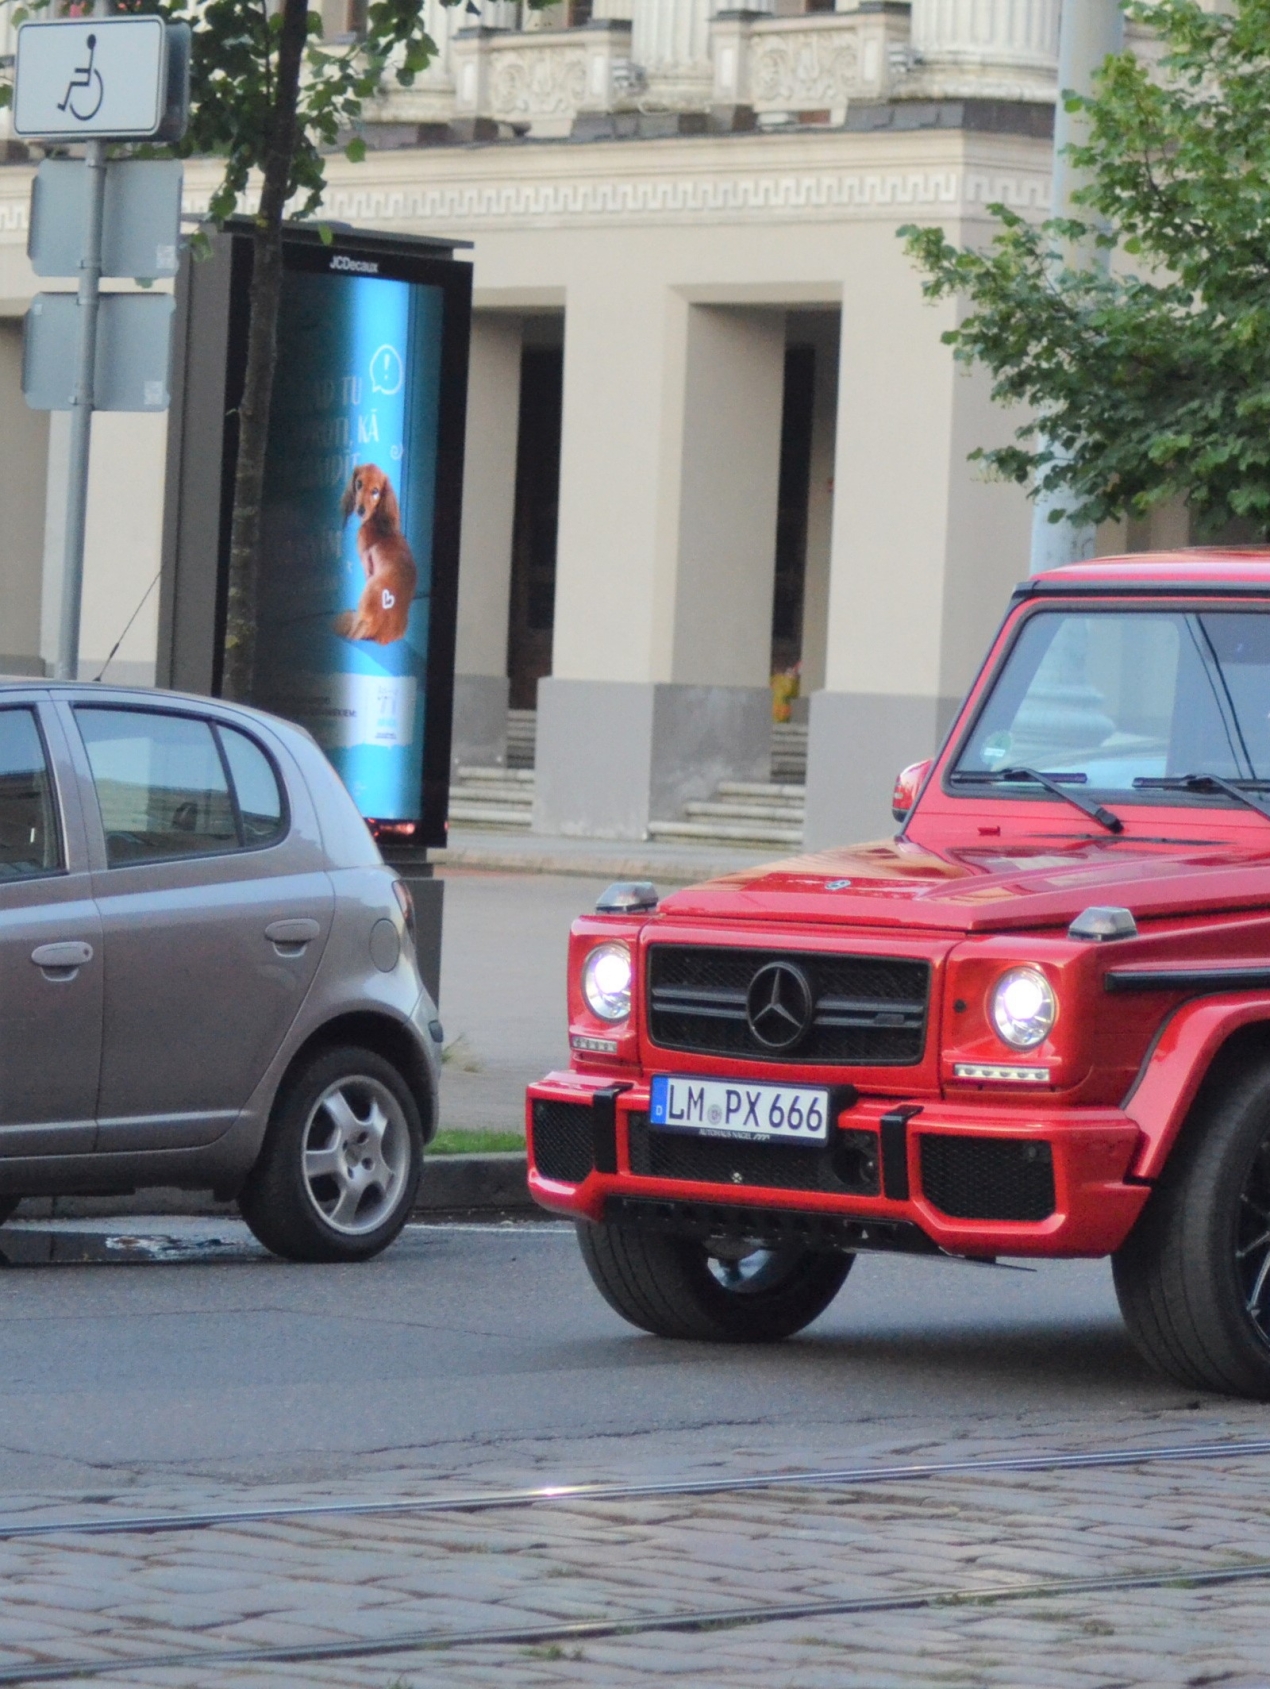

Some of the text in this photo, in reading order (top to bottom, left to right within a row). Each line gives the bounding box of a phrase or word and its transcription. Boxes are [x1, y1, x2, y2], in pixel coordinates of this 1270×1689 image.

[330, 255, 378, 273] JCDecaux
[358, 408, 379, 443] KĀ
[655, 1105, 663, 1116] D
[669, 1084, 823, 1132] LM PX 666
